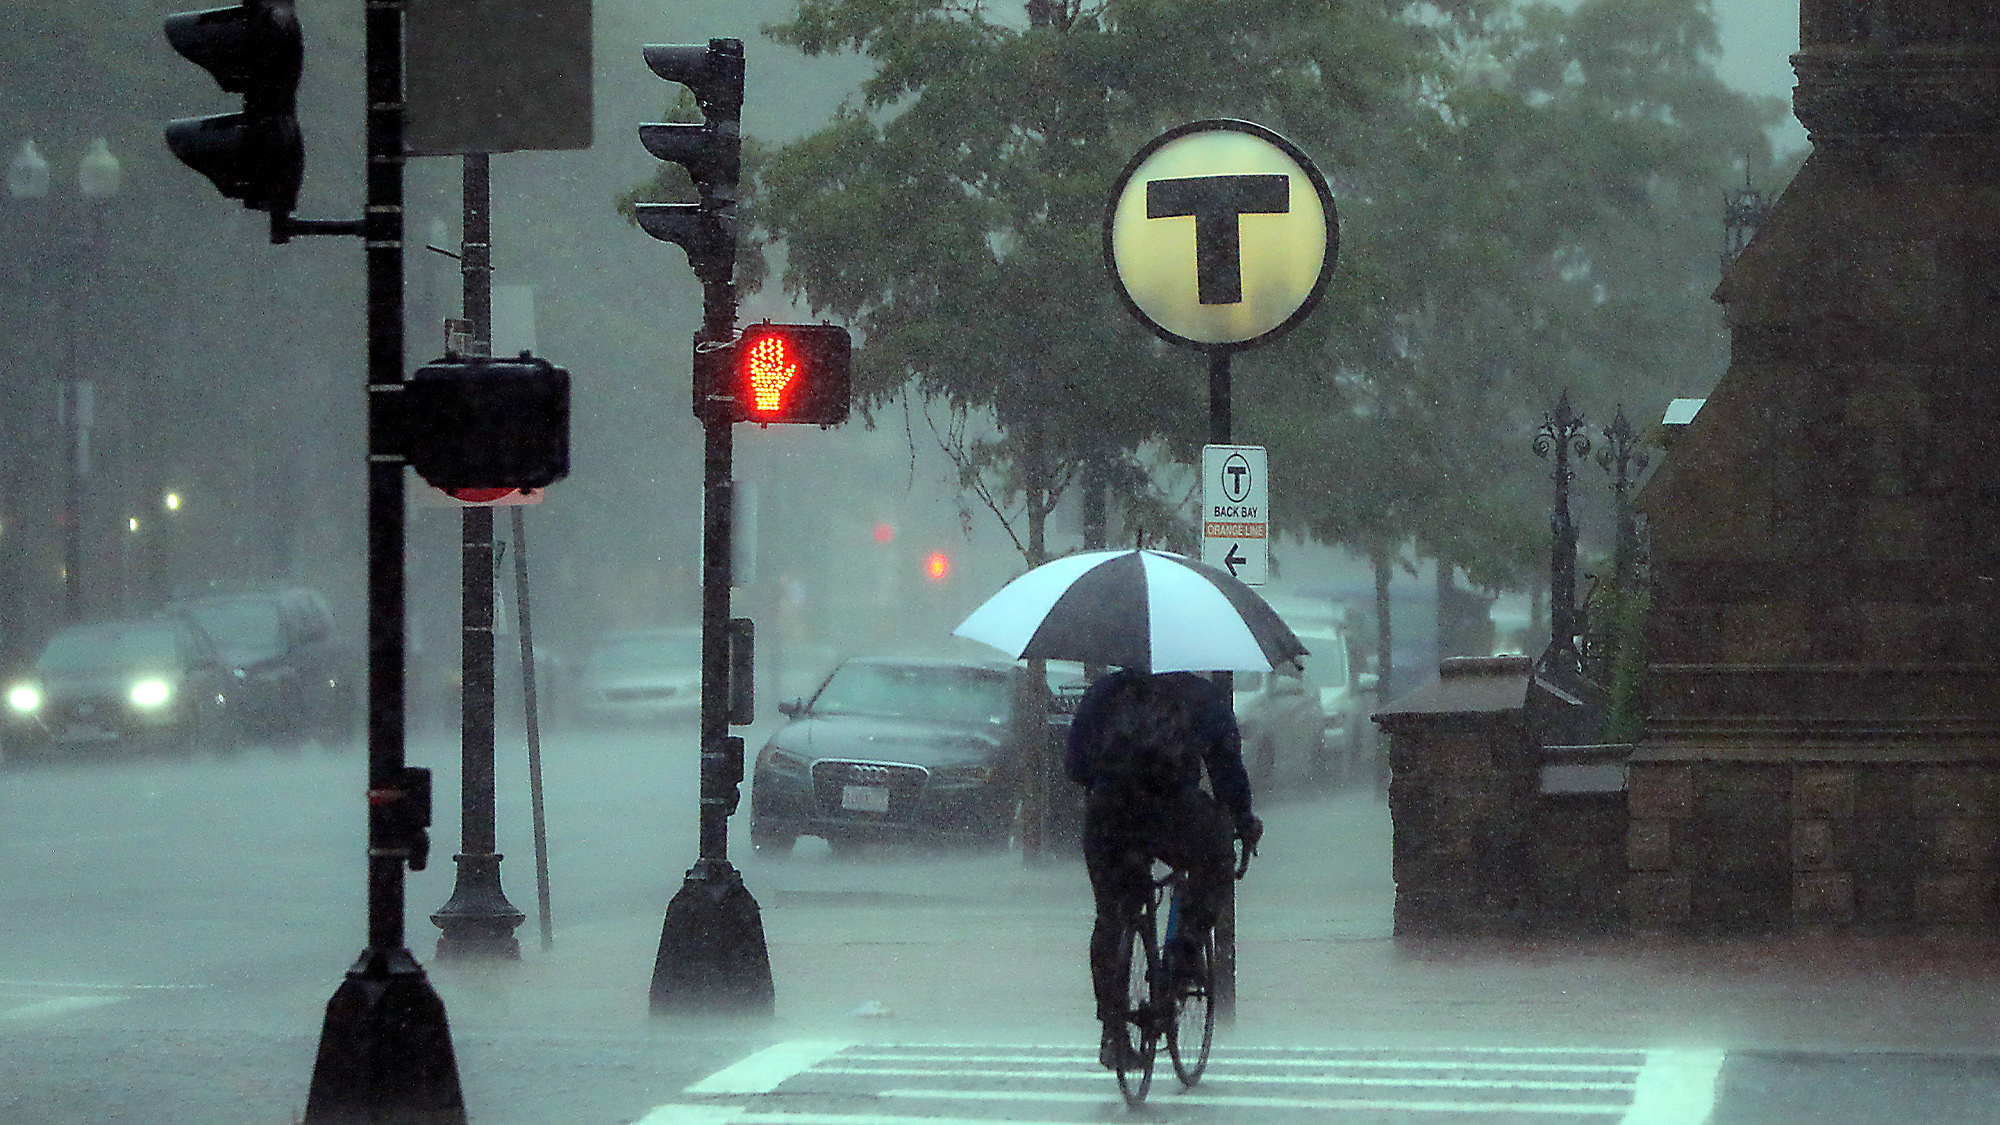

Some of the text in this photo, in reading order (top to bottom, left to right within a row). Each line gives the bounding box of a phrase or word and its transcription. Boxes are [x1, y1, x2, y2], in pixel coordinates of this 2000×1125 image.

[1146, 174, 1290, 305] T
[1227, 466, 1247, 494] T
[1214, 506, 1258, 518] BACK BAY
[1207, 524, 1264, 536] ORANGE LINE
